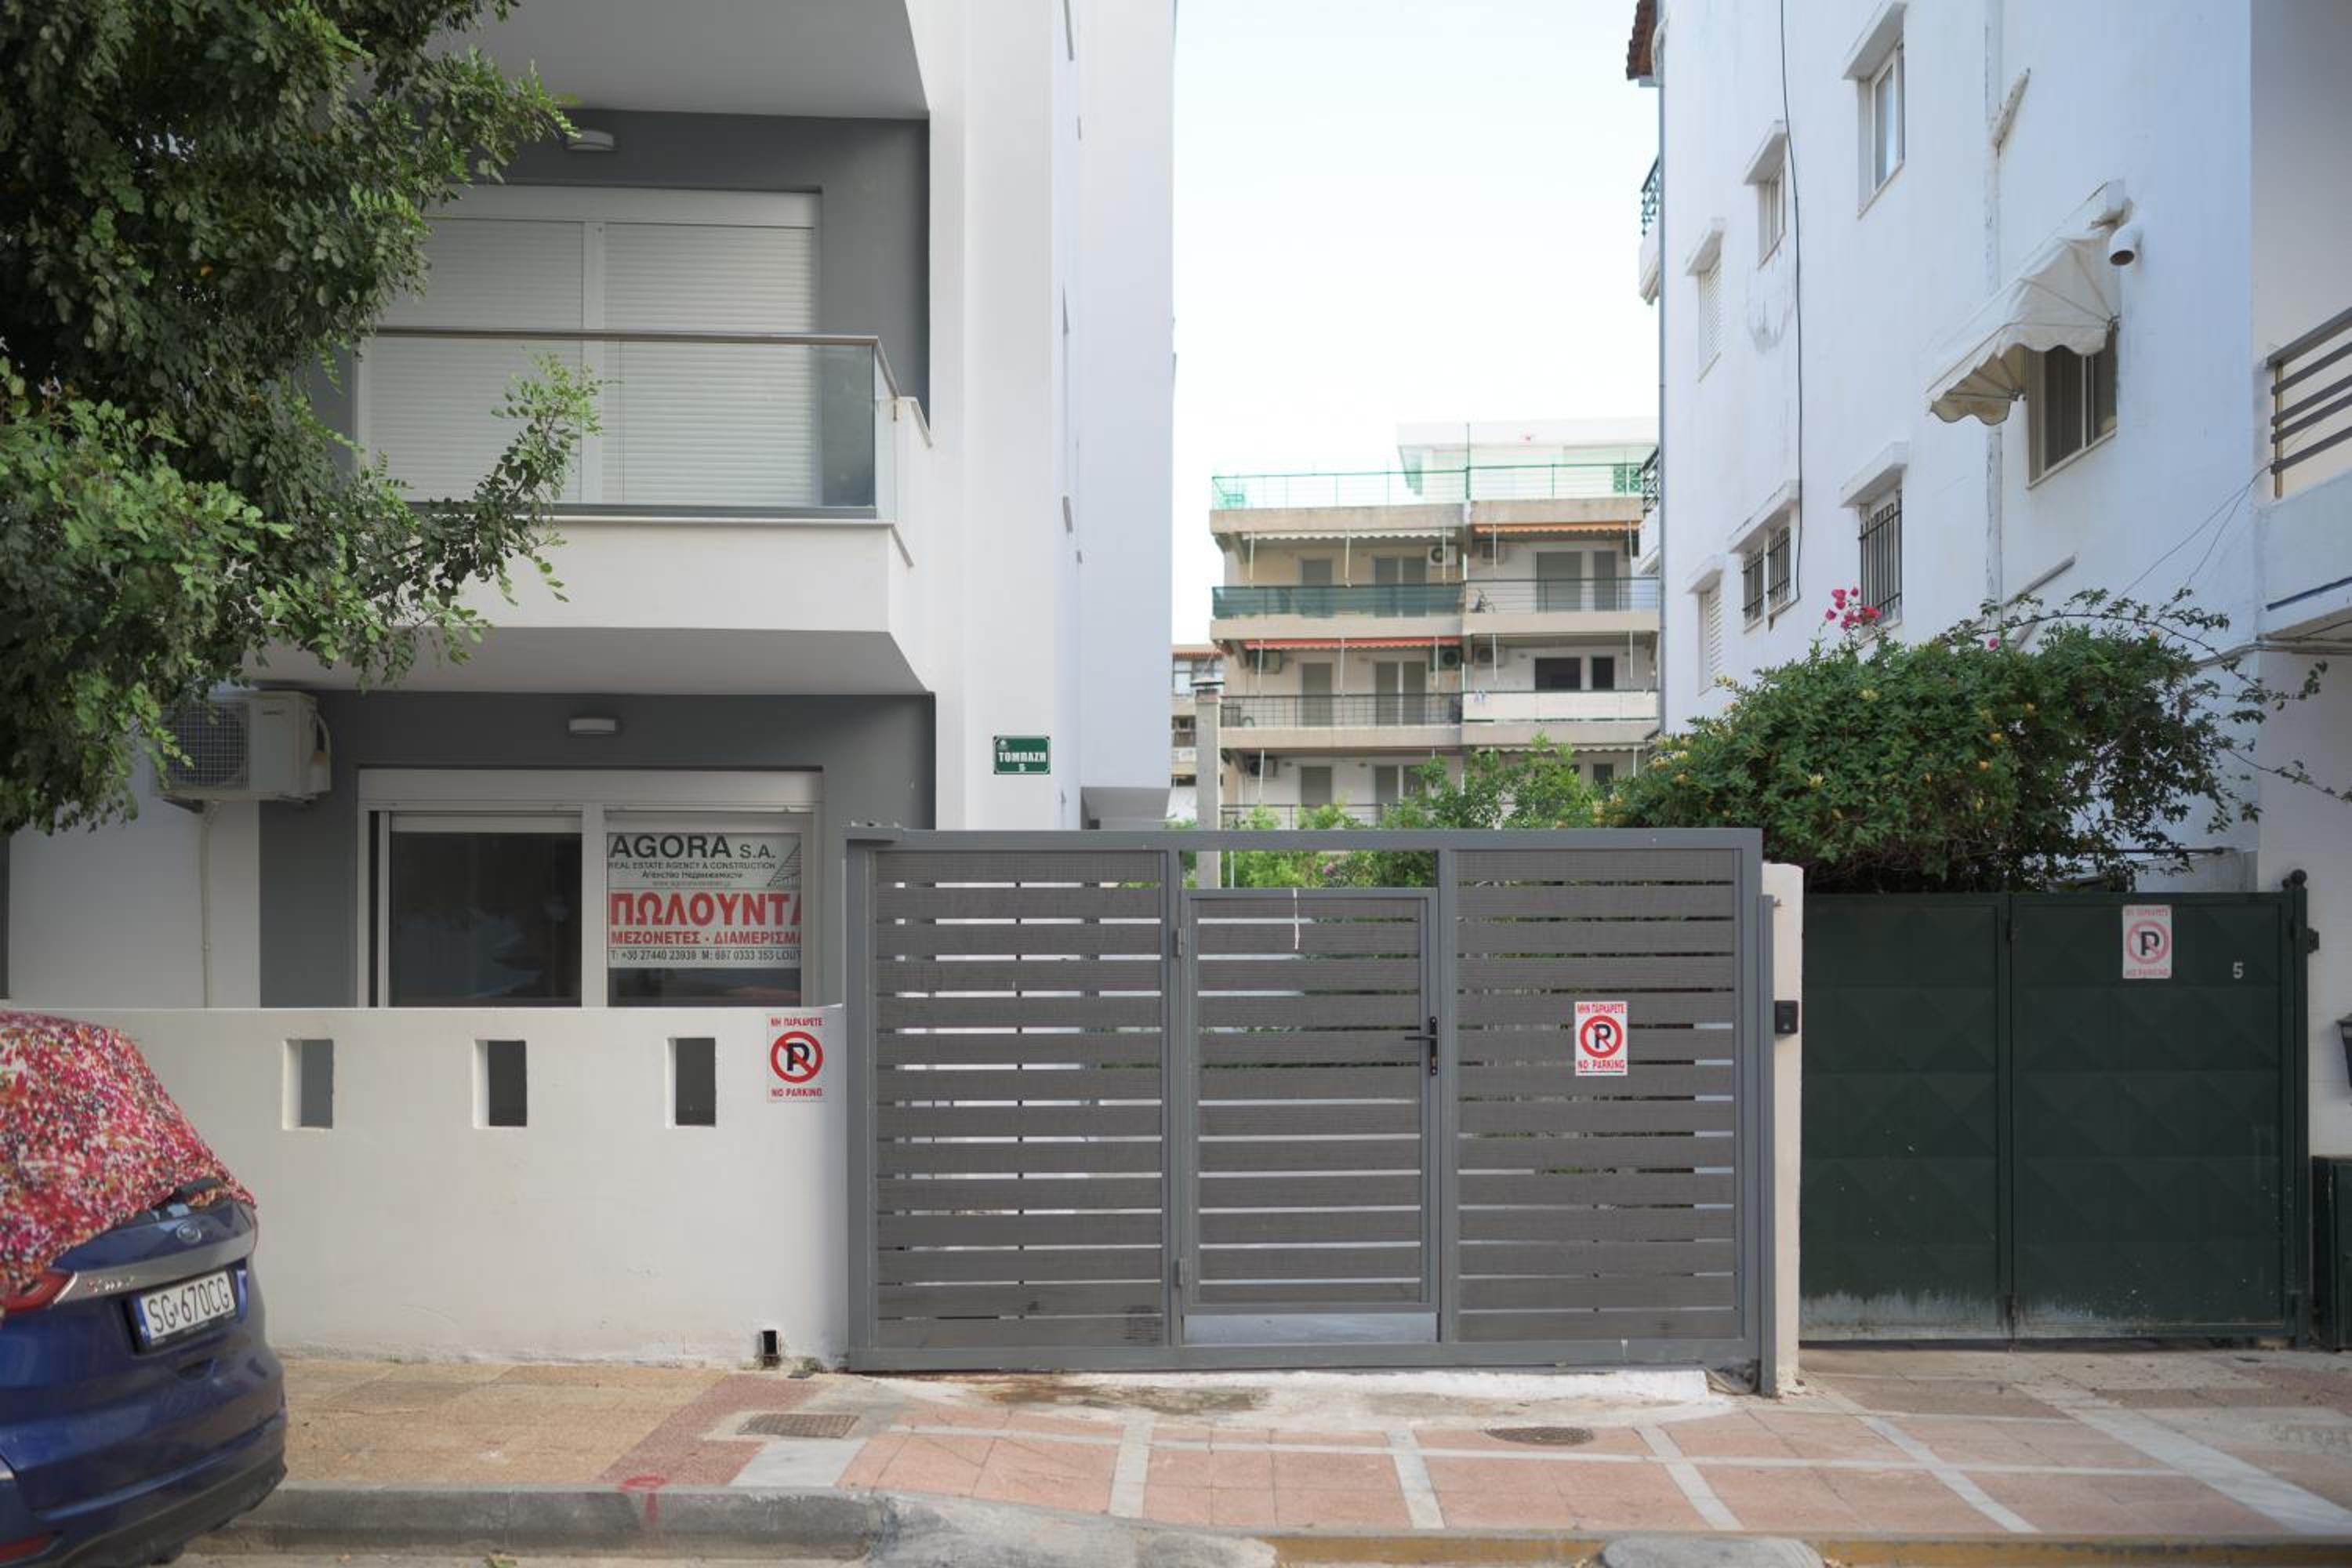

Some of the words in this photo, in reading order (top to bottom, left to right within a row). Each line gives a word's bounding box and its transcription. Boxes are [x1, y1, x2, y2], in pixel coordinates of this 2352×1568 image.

[610, 835, 731, 858] AGORA
[739, 844, 776, 858] S.A.
[612, 931, 702, 945] ΜΕΖΟΝΕΤΕΣ
[2233, 962, 2244, 979] 5
[1577, 1060, 1588, 1069] NO
[1592, 1060, 1625, 1069] PARKING
[771, 1088, 783, 1097] NO
[786, 1087, 822, 1097] PARKING
[147, 1294, 177, 1333] SG
[180, 1276, 230, 1323] 670CG
